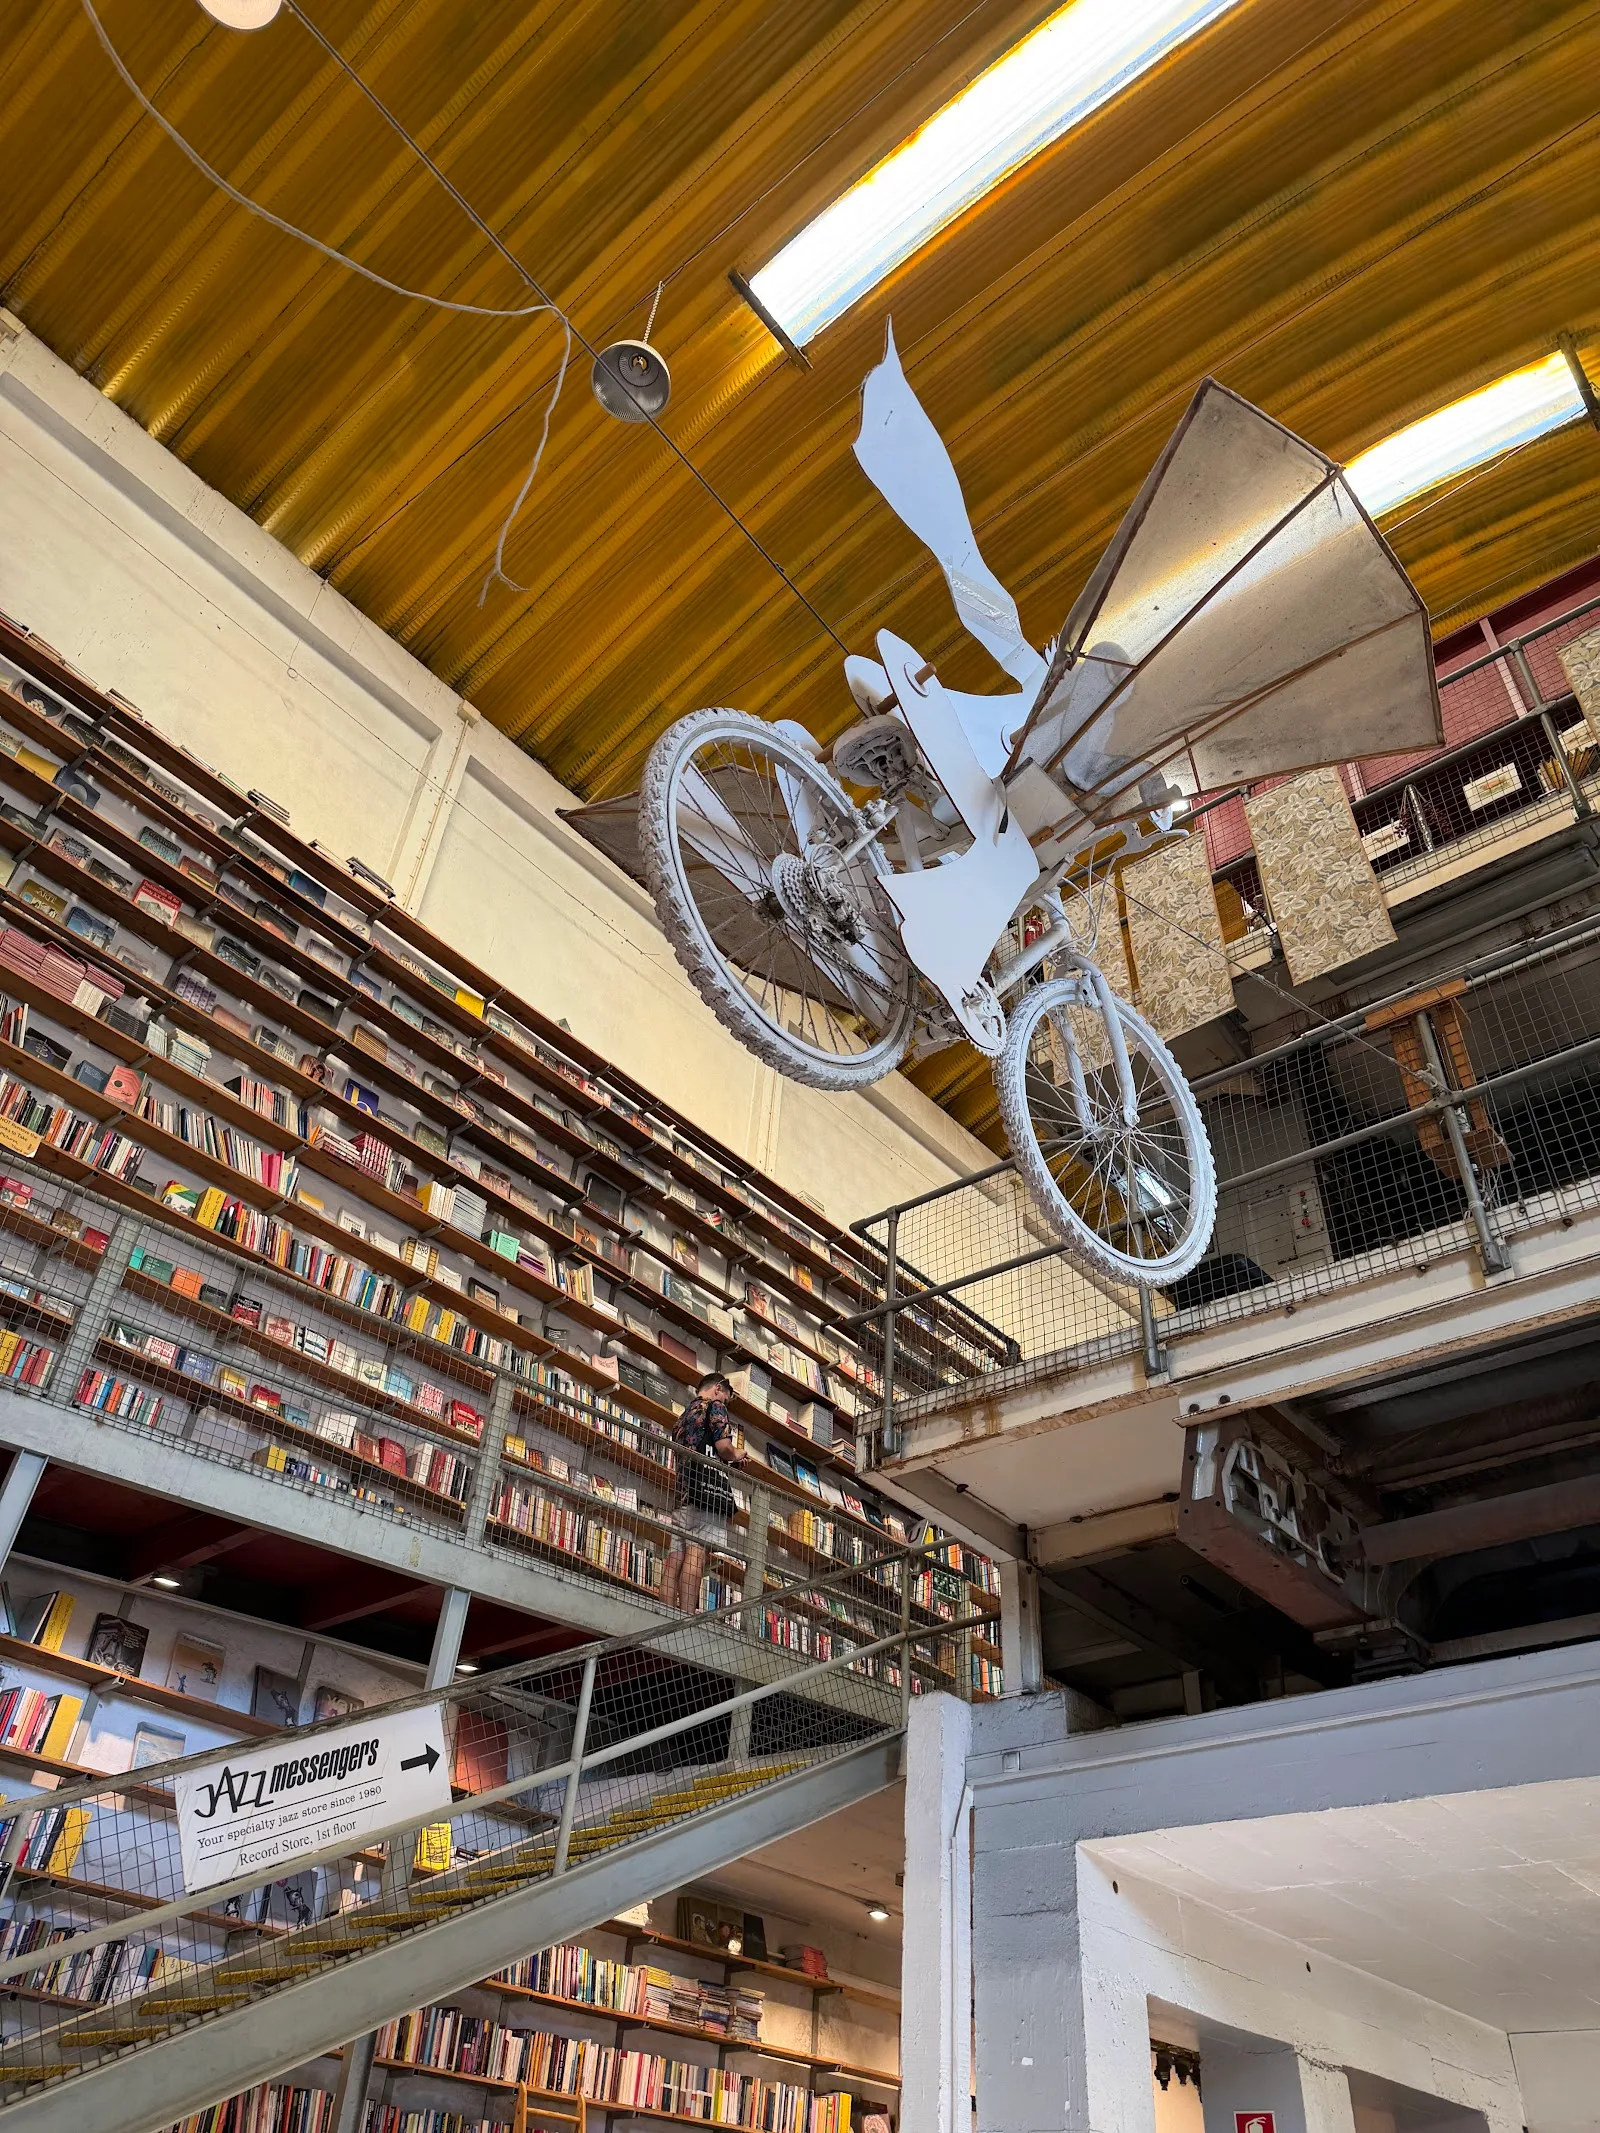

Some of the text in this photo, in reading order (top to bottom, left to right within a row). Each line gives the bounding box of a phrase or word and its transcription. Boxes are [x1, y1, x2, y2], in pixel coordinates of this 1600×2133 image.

[151, 780, 179, 803] 1980
[36, 888, 57, 904] ARTE
[194, 1738, 380, 1818] JAZZ messengers
[197, 1785, 382, 1849] Your specialty jazz store since 1980
[239, 1818, 358, 1866] Record Store, 1st floor
